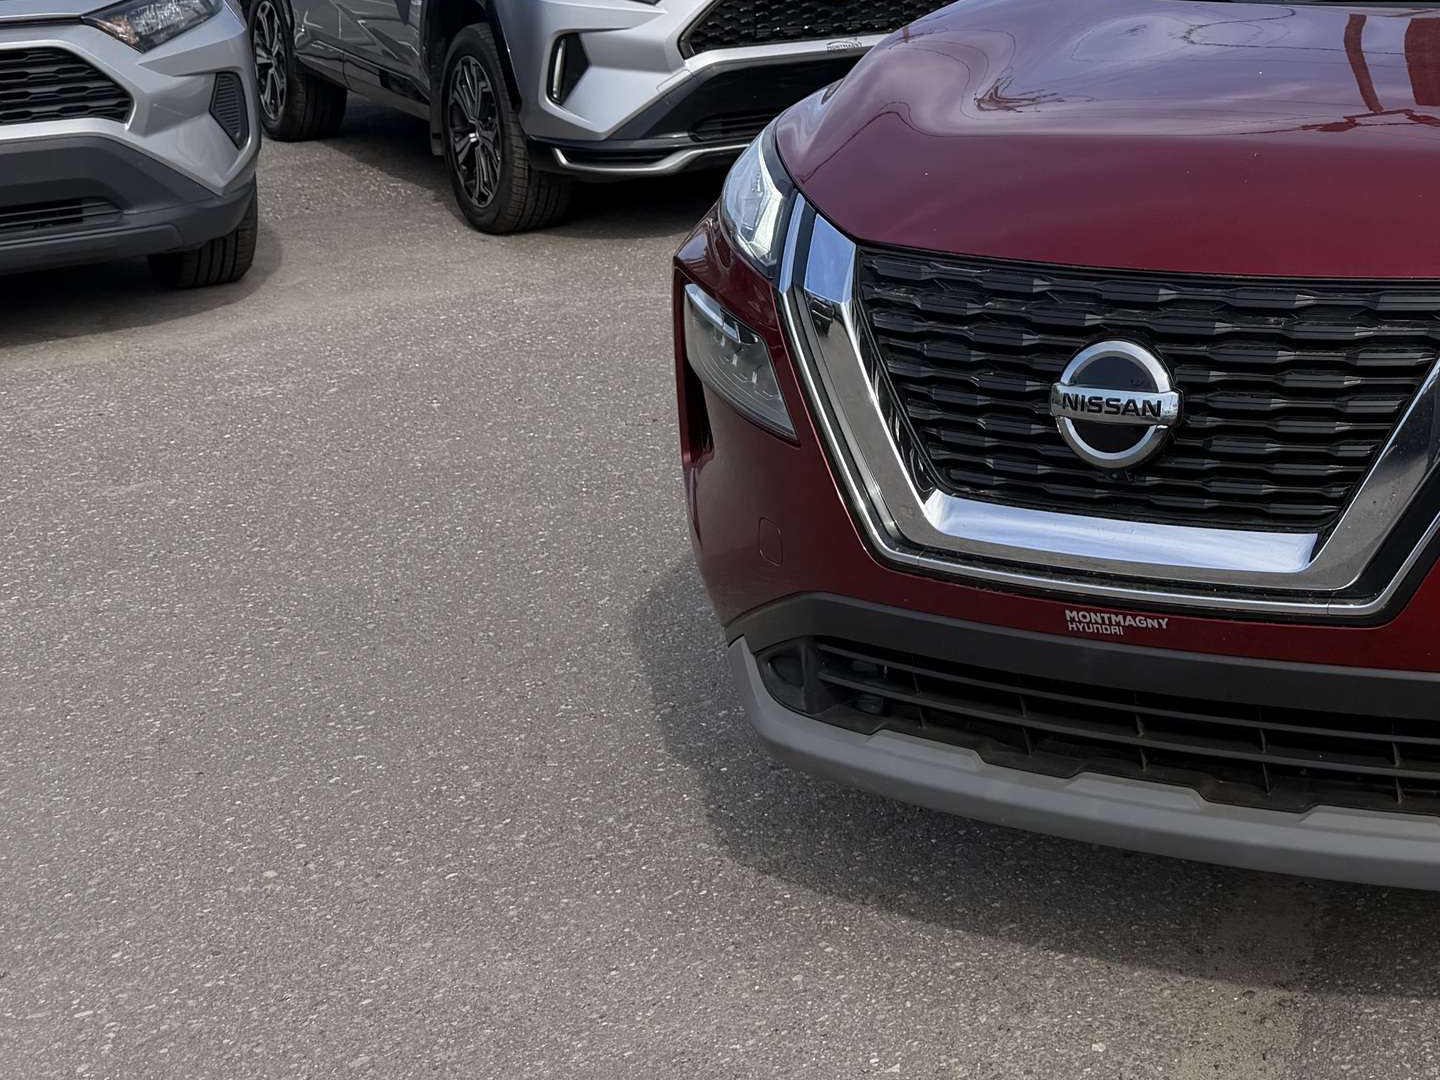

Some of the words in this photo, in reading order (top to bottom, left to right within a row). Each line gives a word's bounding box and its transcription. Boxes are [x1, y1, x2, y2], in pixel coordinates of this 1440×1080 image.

[1061, 392, 1163, 418] NISSAN
[1065, 609, 1169, 629] MONTMAGNY
[1067, 621, 1124, 636] HYUNDAI
